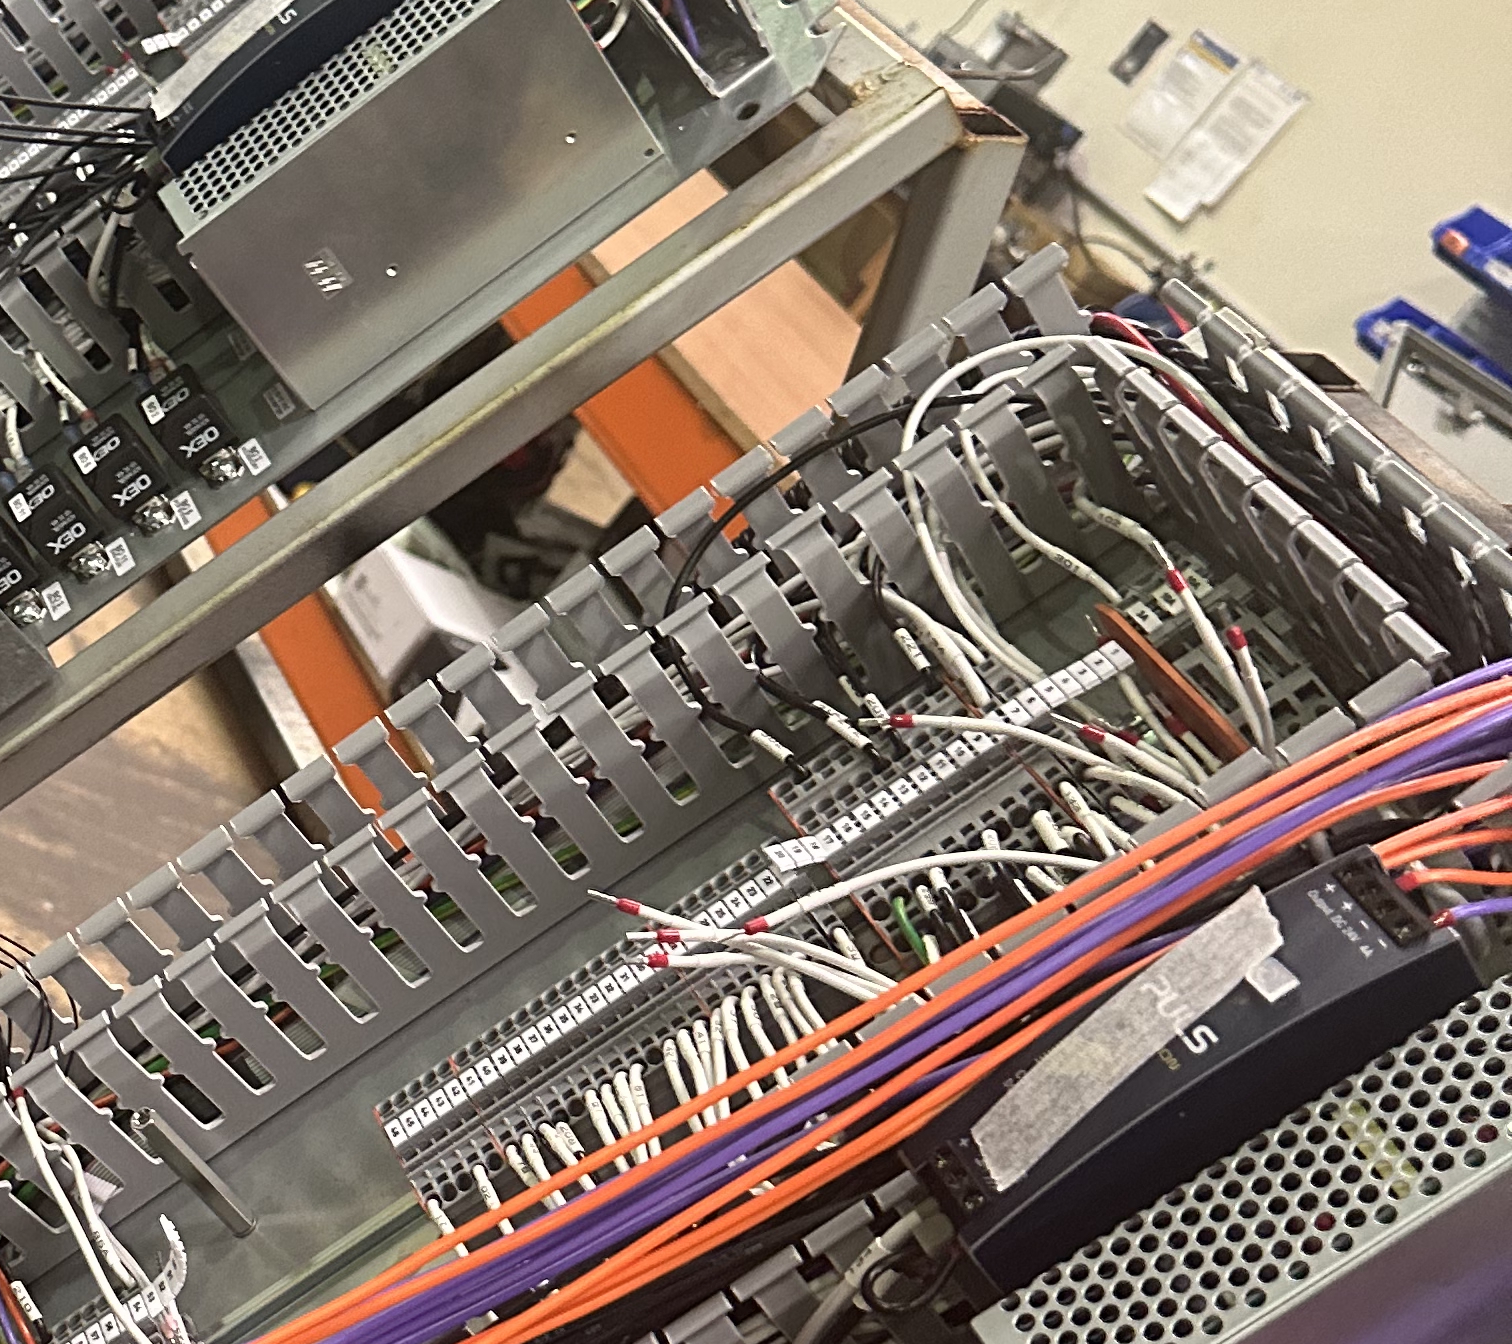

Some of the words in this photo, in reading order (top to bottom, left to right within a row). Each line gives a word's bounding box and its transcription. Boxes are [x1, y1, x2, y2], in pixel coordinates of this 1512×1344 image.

[179, 425, 220, 459] OEX
[111, 472, 153, 507] OEX
[46, 521, 87, 555] OEX
[1329, 912, 1347, 930] DC
